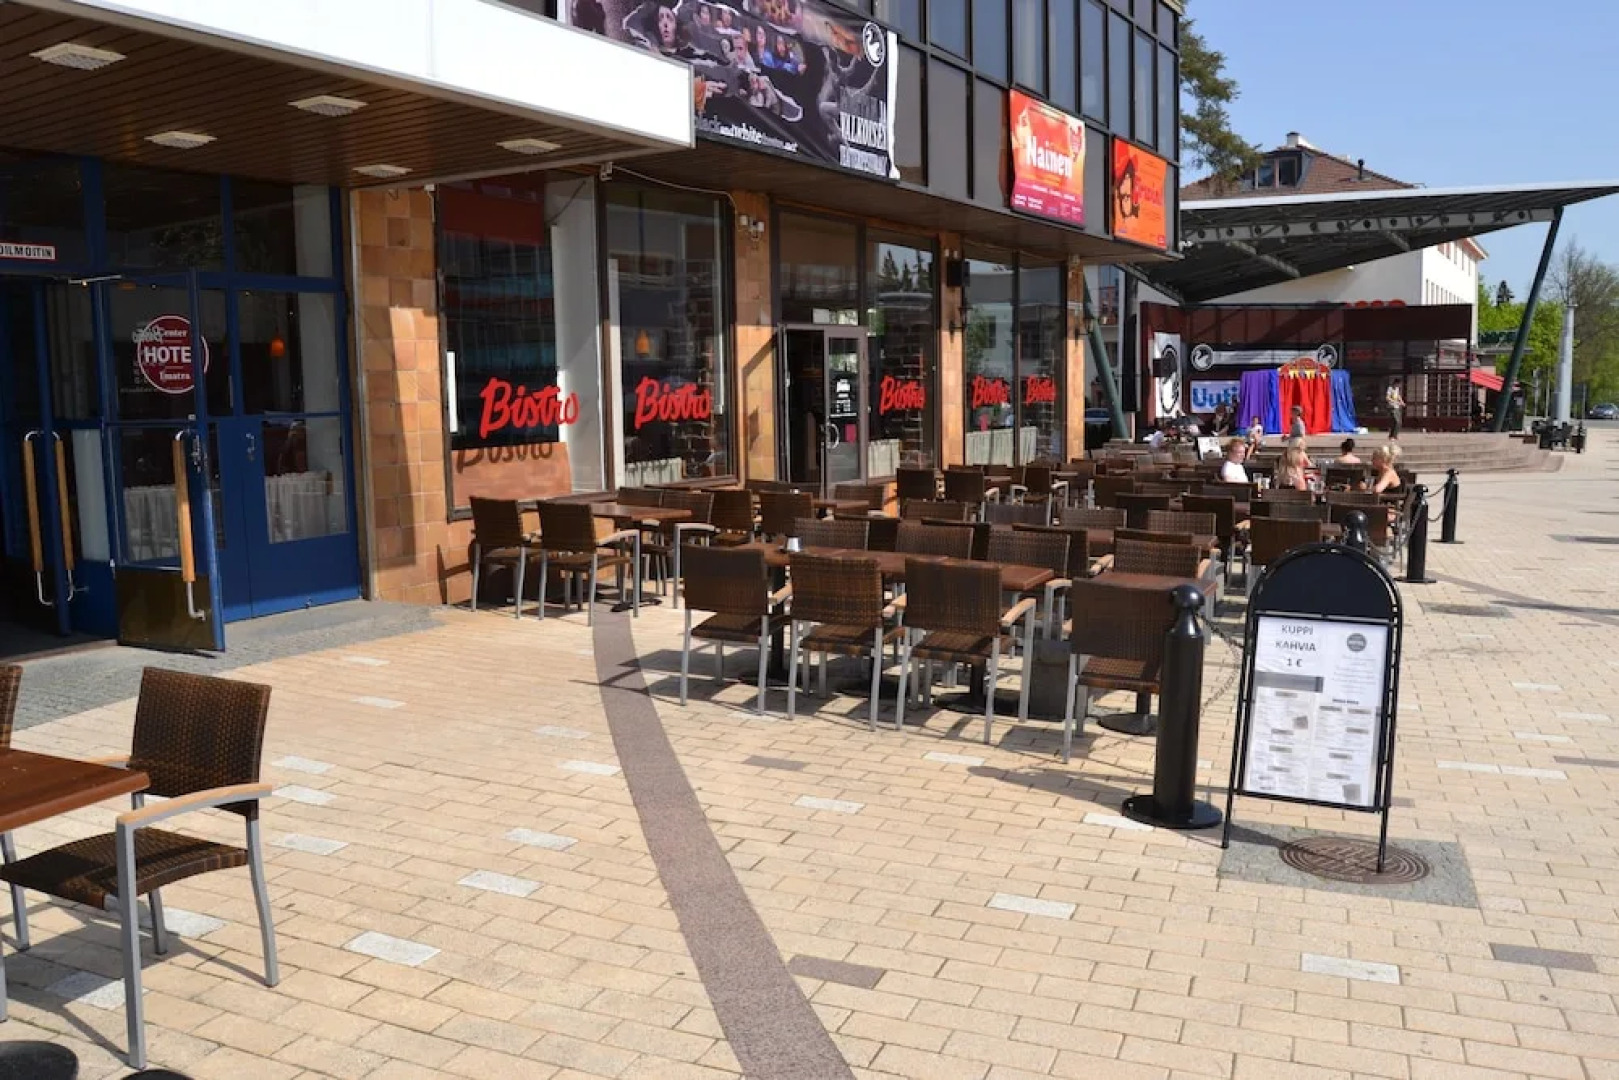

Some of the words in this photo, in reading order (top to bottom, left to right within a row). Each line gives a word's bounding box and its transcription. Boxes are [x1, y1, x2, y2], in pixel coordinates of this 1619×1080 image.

[1026, 135, 1073, 179] Nainen
[144, 345, 192, 363] HOTE
[480, 376, 579, 438] Bistro
[635, 376, 712, 429] Bistro
[880, 374, 926, 415] Bistro
[972, 374, 1009, 410] Bistro
[1026, 375, 1056, 406] Bistro
[1275, 640, 1317, 652] KAHVIA
[1281, 624, 1314, 635] KUPPI
